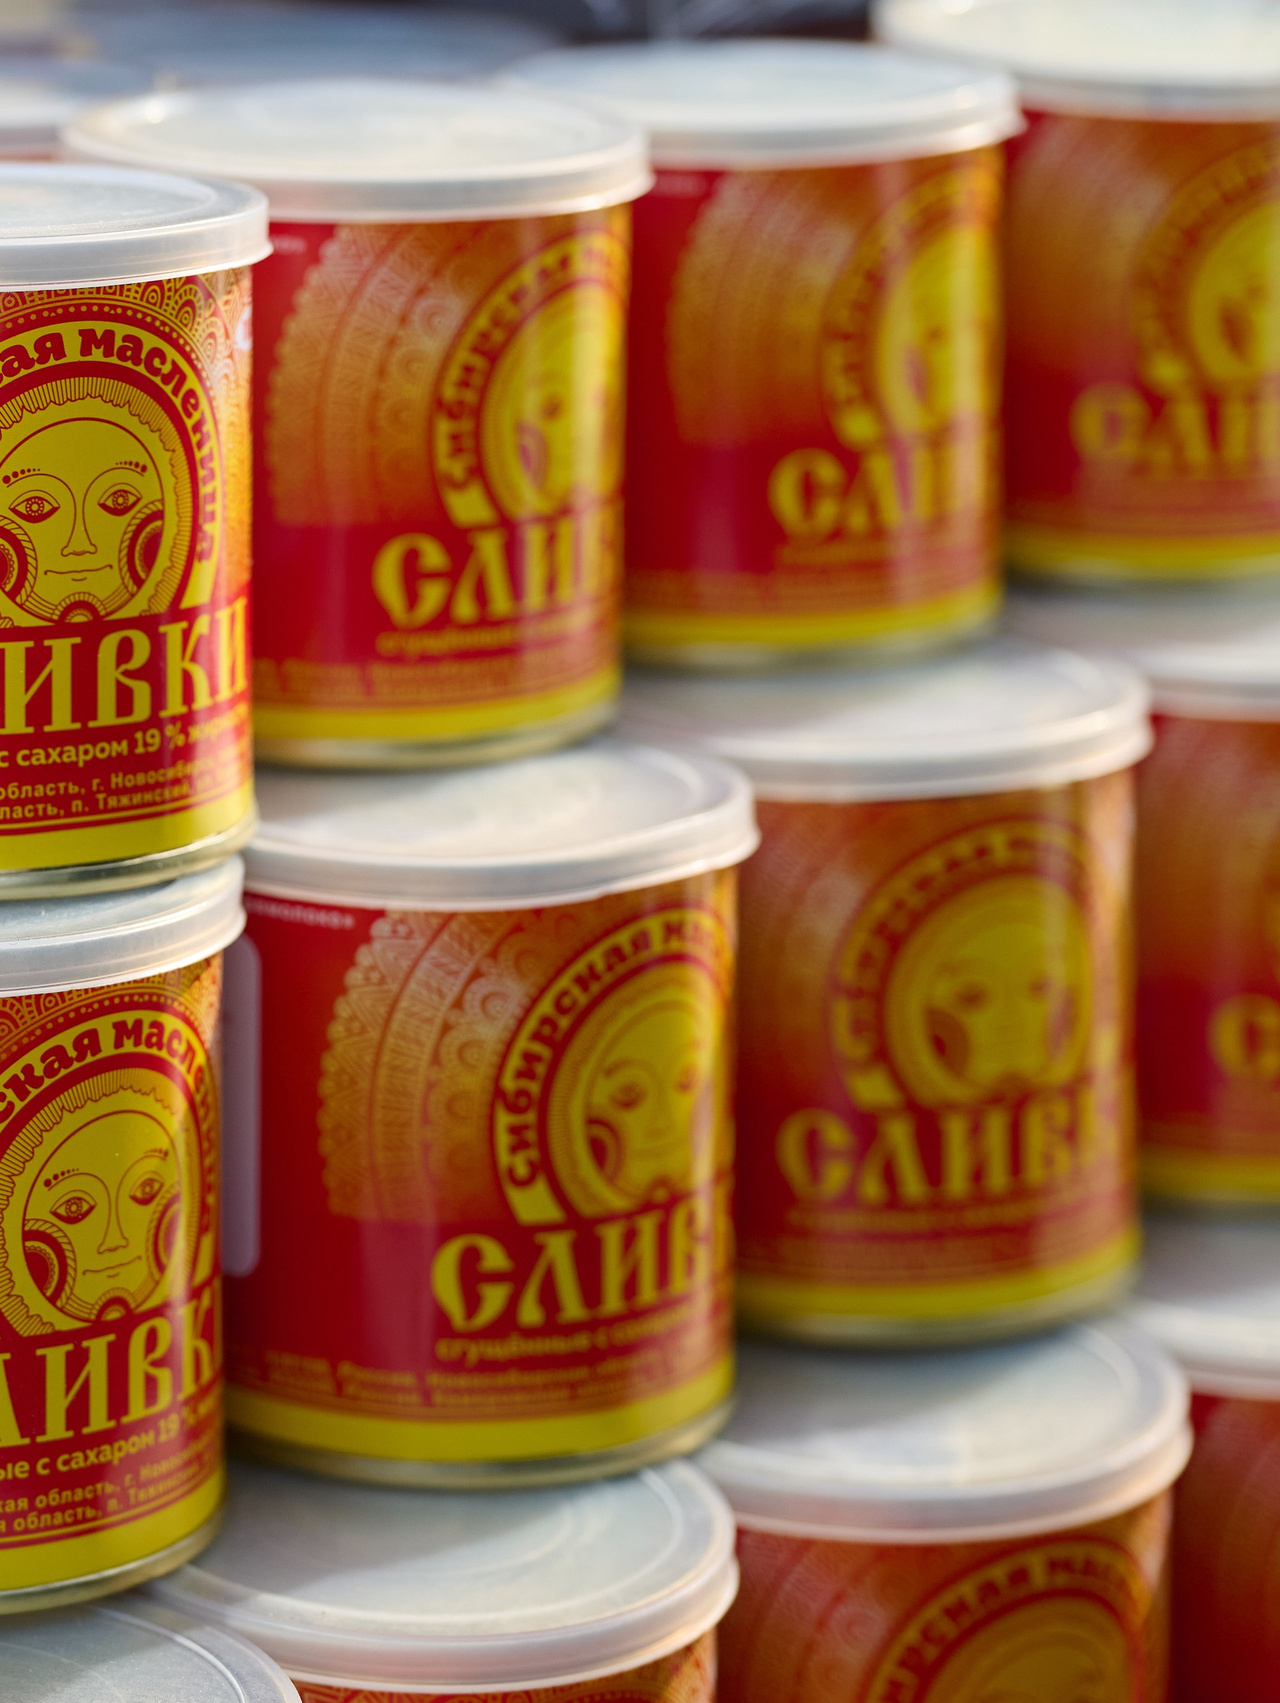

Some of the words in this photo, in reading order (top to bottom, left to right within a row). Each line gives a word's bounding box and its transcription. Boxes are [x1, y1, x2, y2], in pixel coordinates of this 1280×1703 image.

[78, 327, 217, 563] масленица
[16, 738, 128, 768] сахаром
[134, 728, 162, 754] 19
[431, 1202, 710, 1332] СЛИВ
[36, 1457, 51, 1476] с
[56, 1428, 156, 1472] сахаром
[158, 1412, 180, 1443] 19
